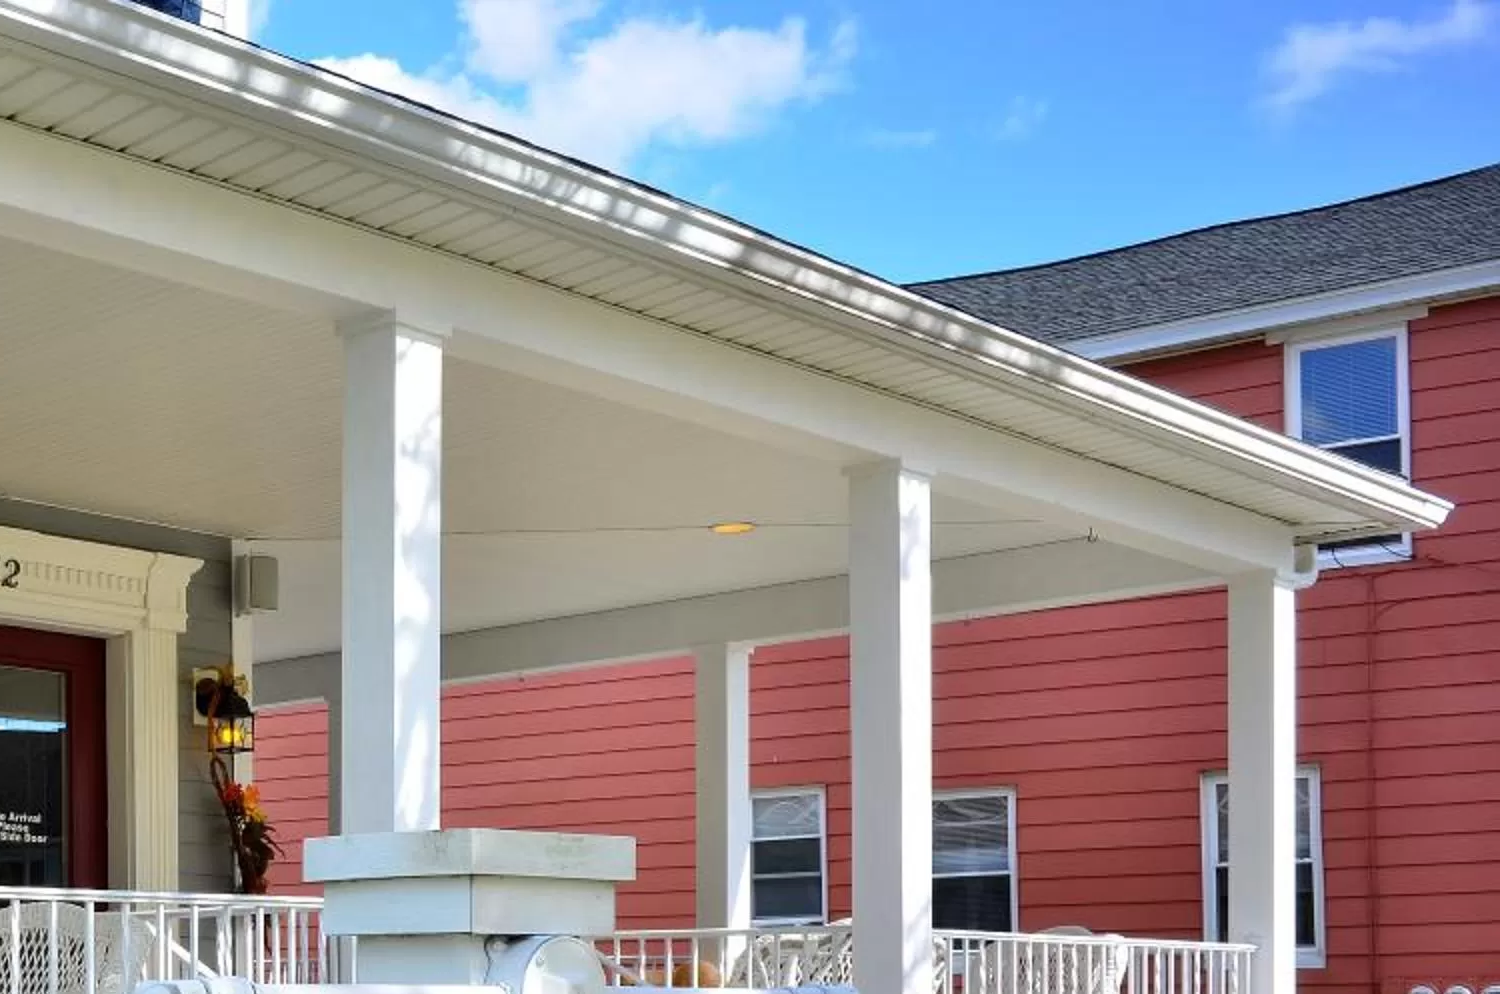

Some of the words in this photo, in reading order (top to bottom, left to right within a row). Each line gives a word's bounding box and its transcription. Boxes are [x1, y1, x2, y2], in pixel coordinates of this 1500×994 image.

[8, 812, 41, 823] Arrival
[0, 831, 21, 842] Side
[24, 833, 48, 843] Door
